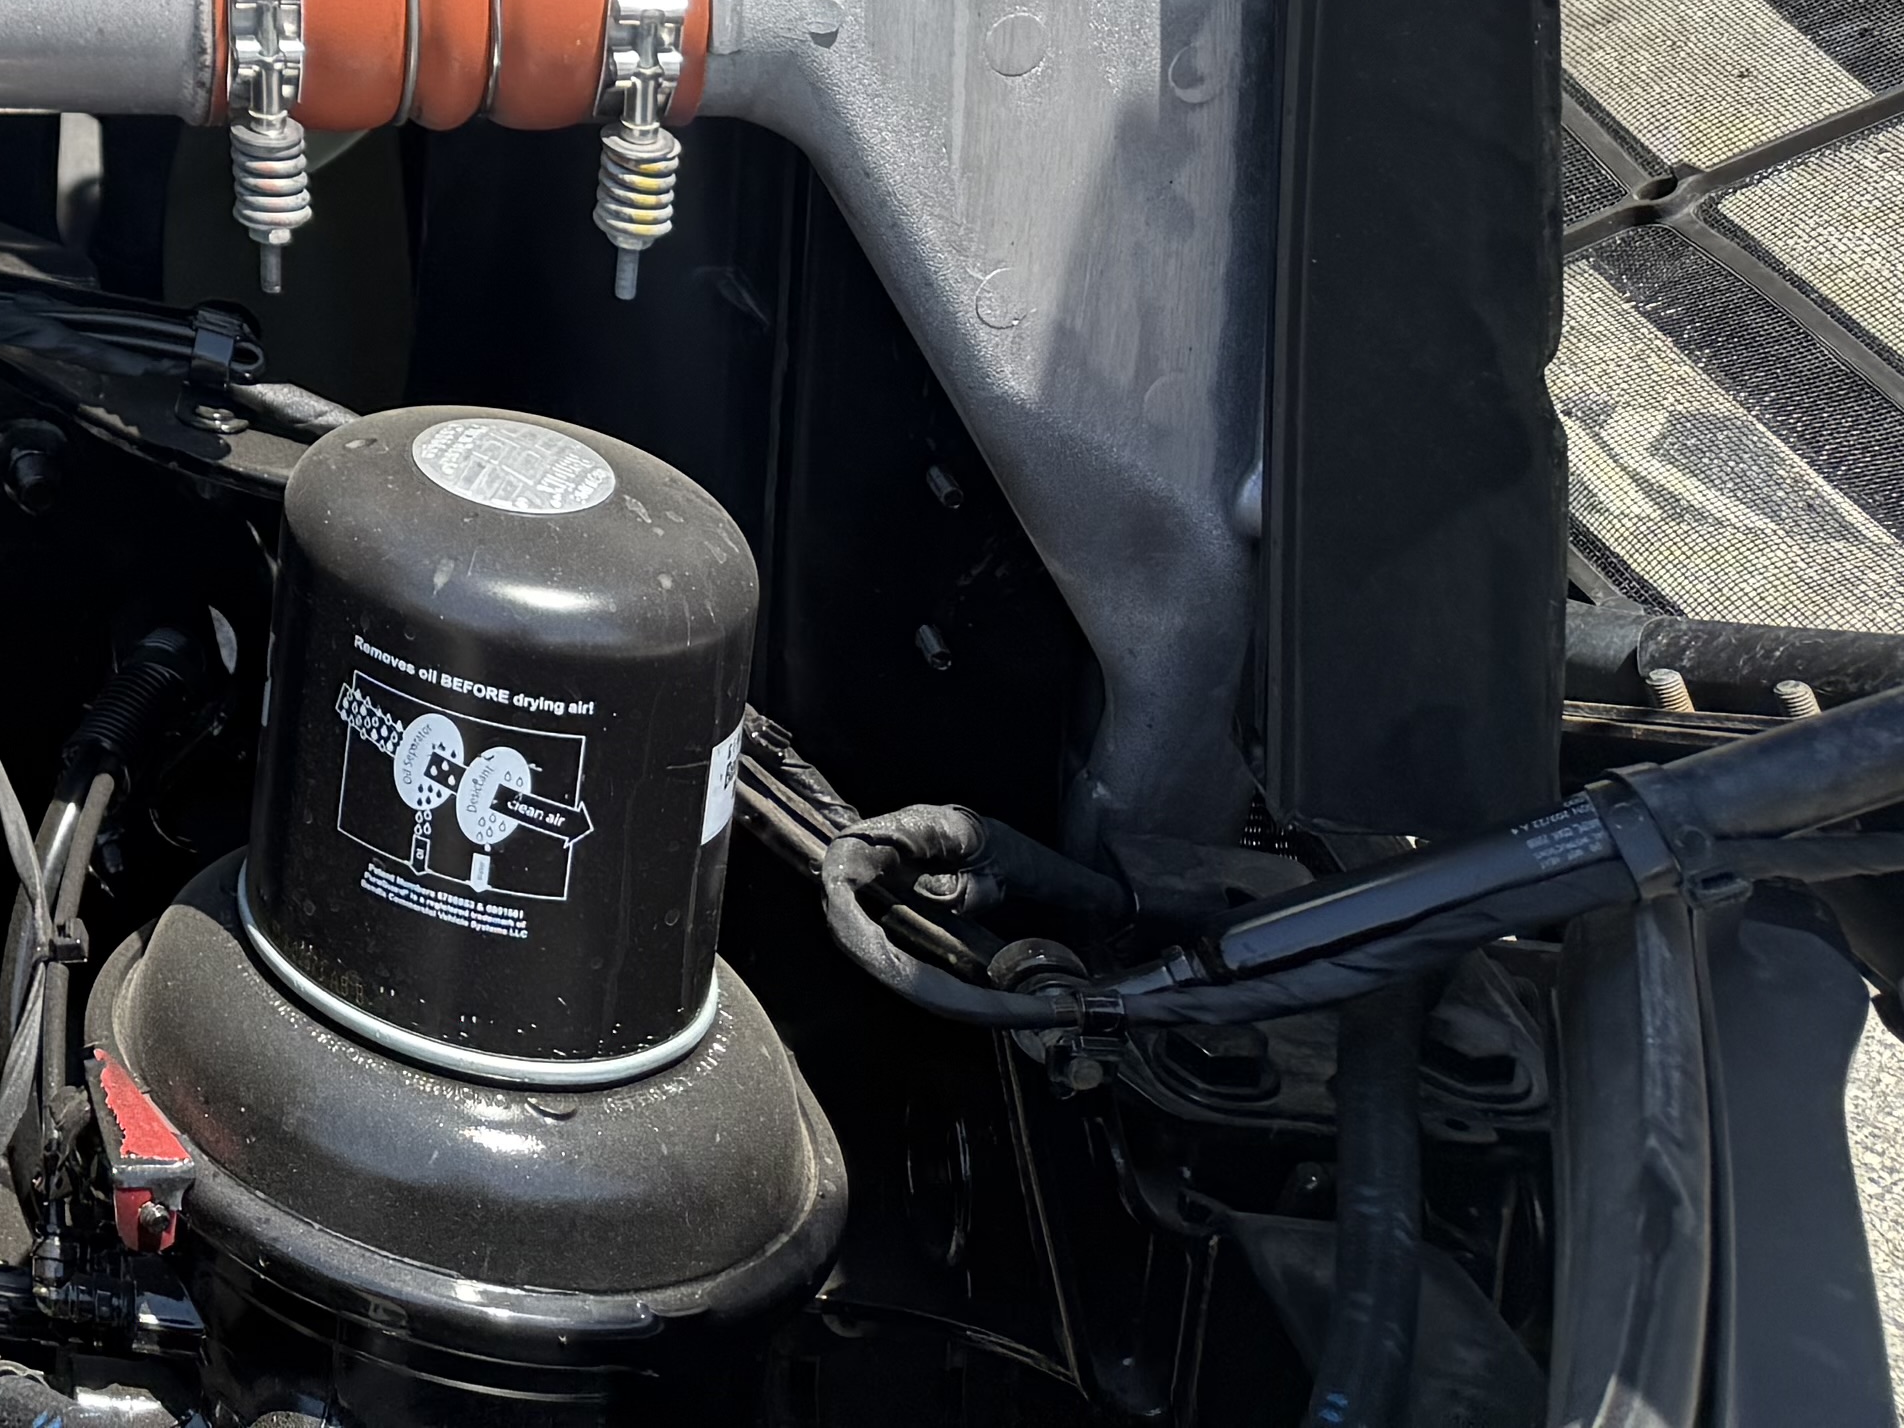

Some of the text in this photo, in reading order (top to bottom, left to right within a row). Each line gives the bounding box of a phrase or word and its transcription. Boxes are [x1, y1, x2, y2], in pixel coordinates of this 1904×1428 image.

[352, 633, 595, 716] Removes oil BEFORE drying air!
[402, 722, 433, 785] Oil Separator
[545, 808, 566, 828] air
[396, 875, 435, 898] Numbers
[508, 927, 529, 939] LLC
